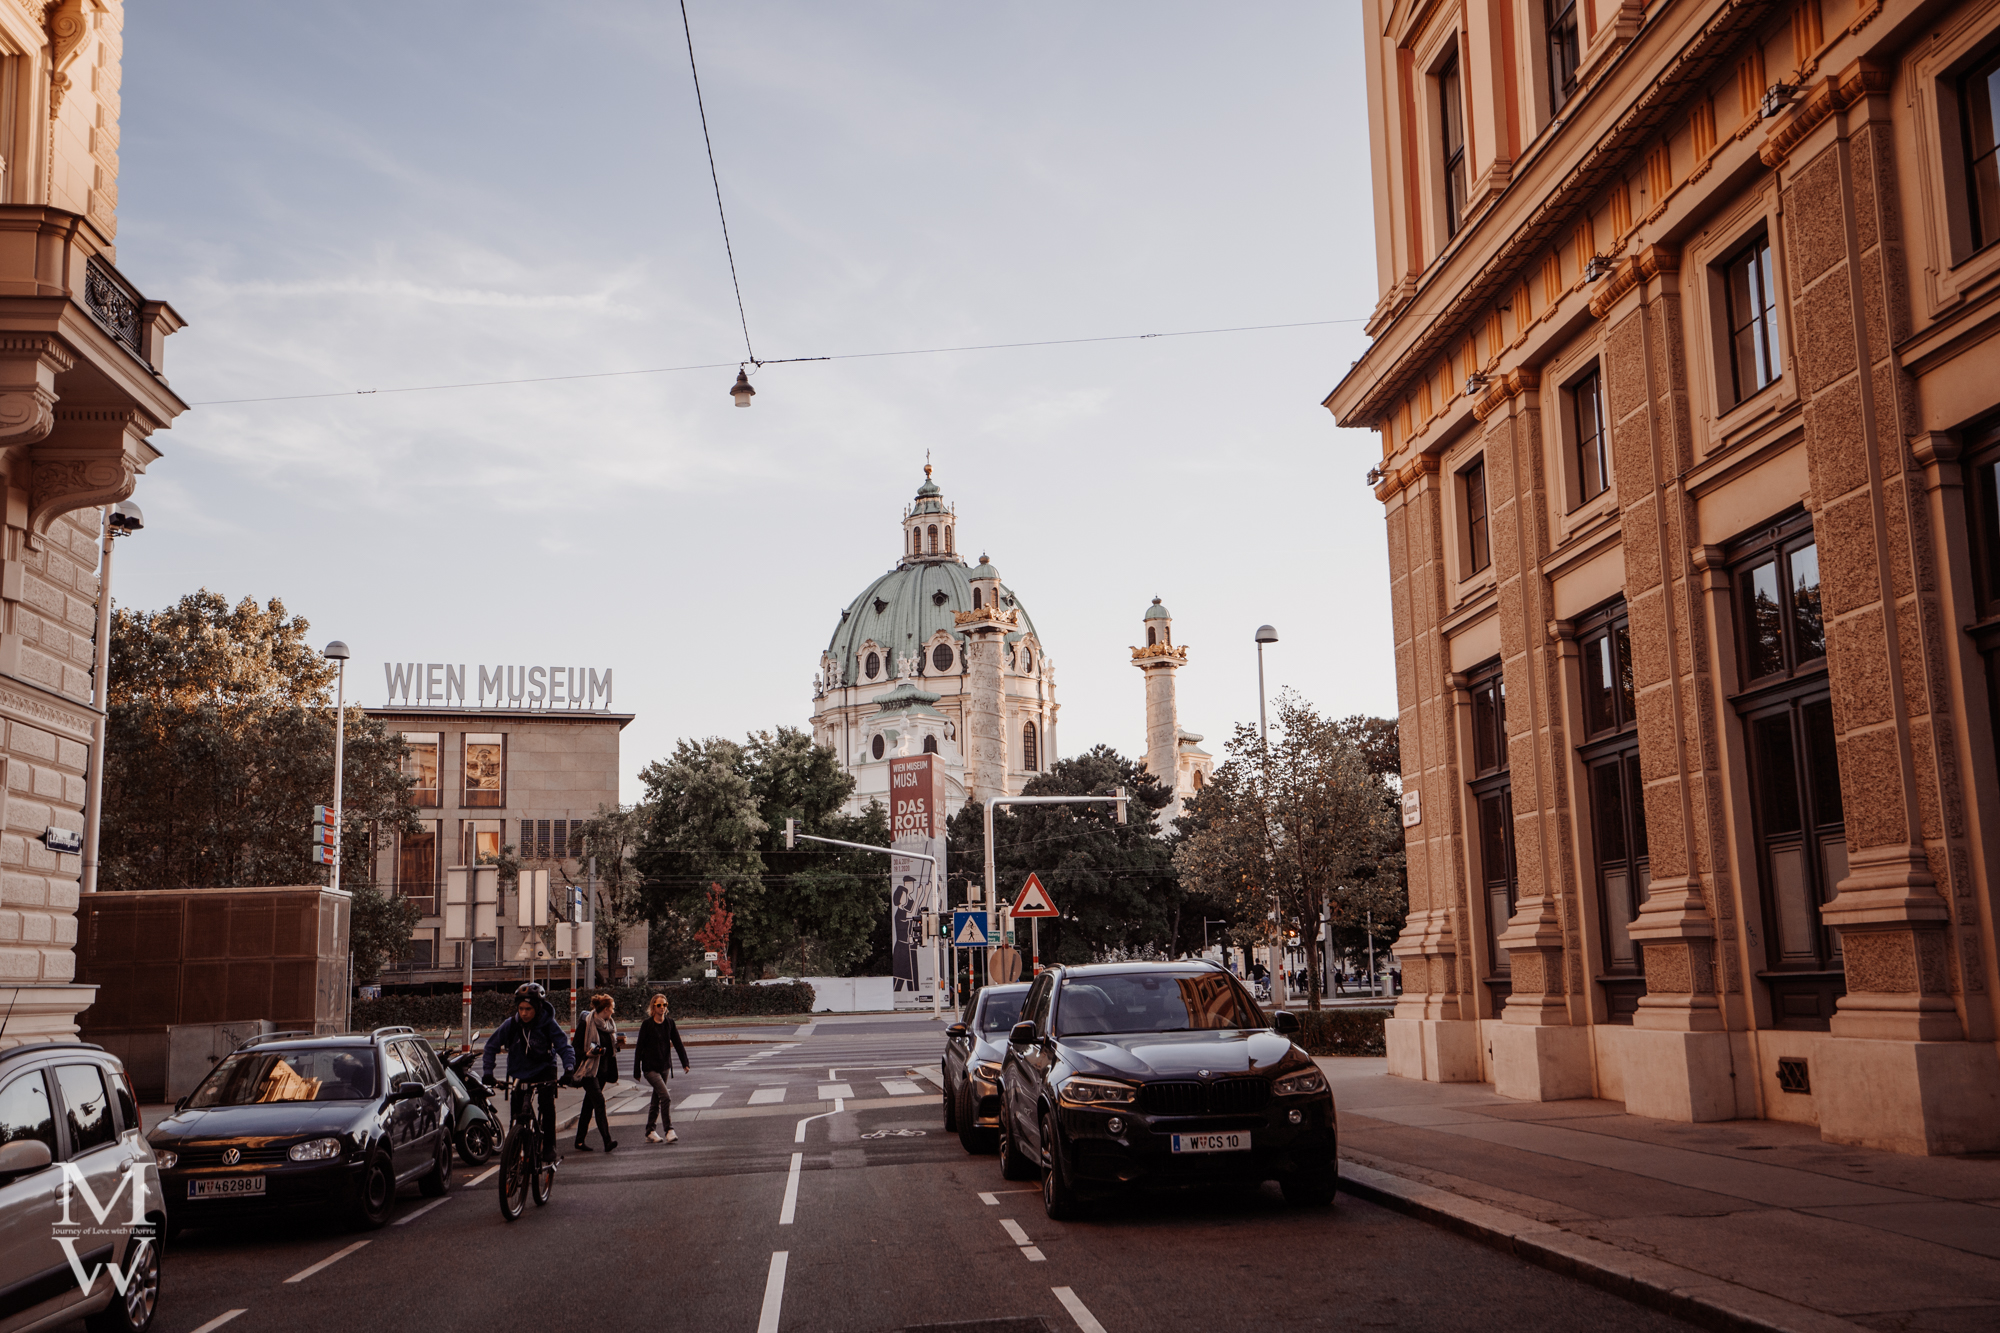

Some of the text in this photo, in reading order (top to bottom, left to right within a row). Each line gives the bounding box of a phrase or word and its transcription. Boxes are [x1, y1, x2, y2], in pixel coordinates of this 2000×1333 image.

[385, 662, 612, 704] WIEN MUSEUM
[893, 763, 905, 773] WIEN
[906, 760, 928, 771] MUSEUM
[893, 772, 918, 789] MUSA
[897, 798, 925, 815] DAS
[895, 812, 928, 830] ROTE
[893, 827, 929, 845] WIEN
[1226, 1134, 1239, 1148] 10
[215, 1179, 251, 1193] 46298
[255, 1178, 262, 1190] U
